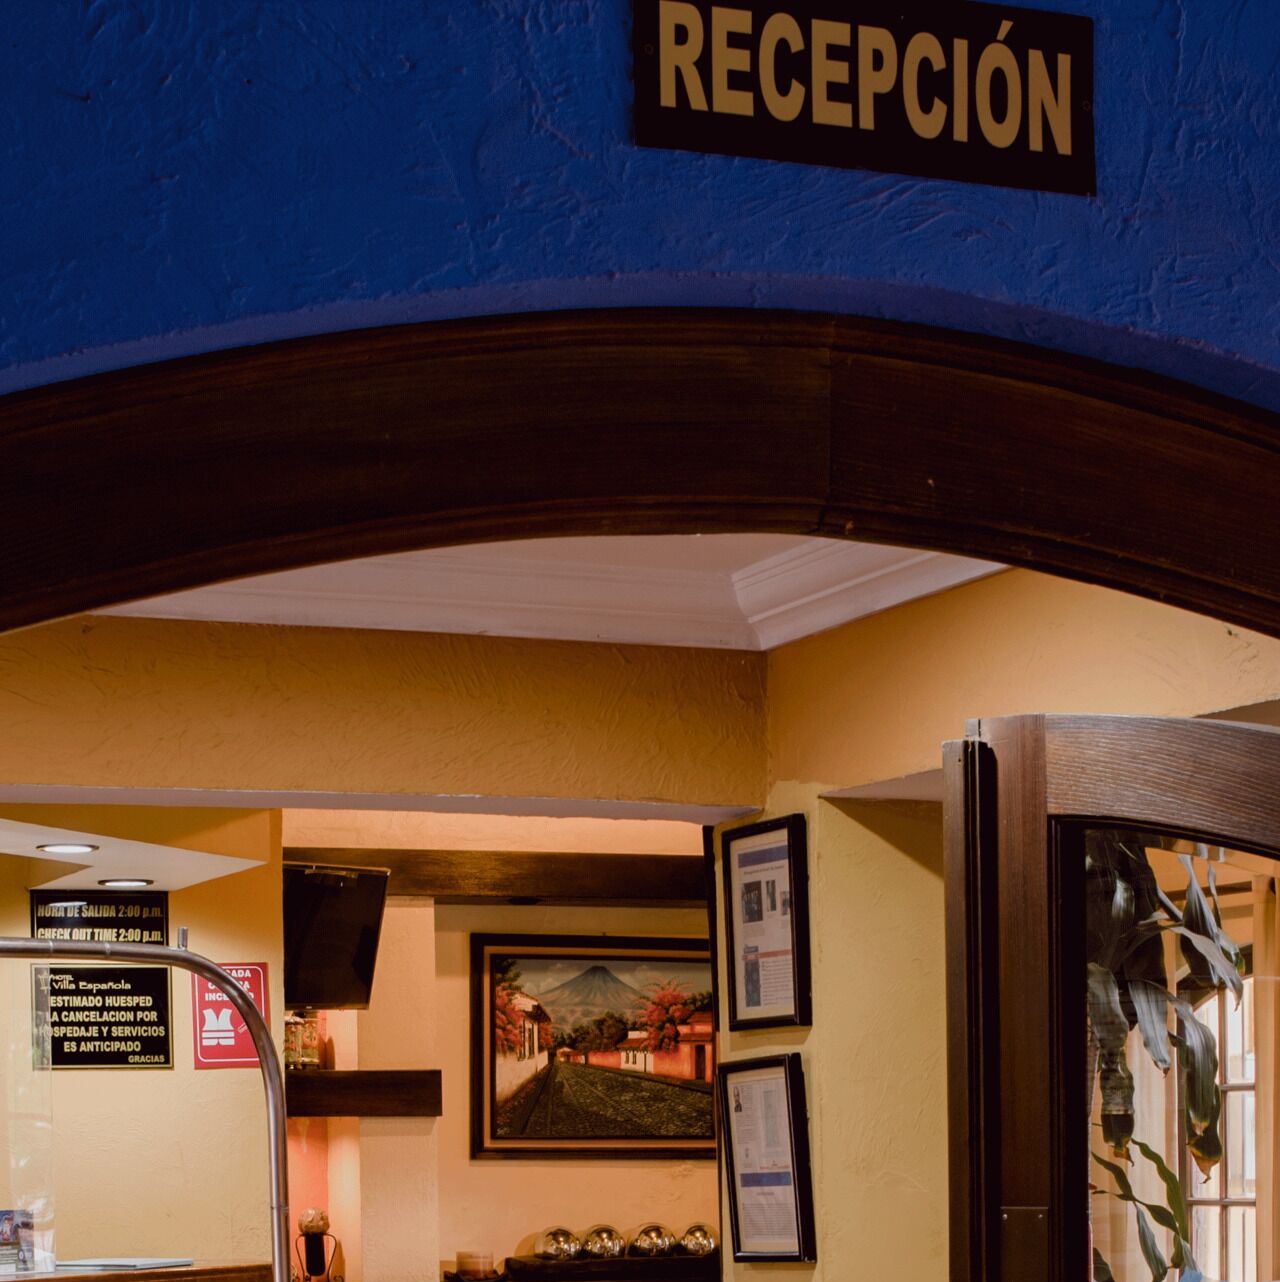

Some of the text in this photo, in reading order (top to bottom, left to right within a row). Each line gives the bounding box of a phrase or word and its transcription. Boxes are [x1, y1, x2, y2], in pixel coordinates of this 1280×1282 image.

[659, 2, 1072, 156] RECEPCIÓN
[37, 905, 163, 919] HORA DE SALIDA 2:00 p.m.
[37, 928, 163, 943] CHECK OUT TIME 2:00 p.m.
[52, 979, 132, 993] Villa Española
[50, 995, 153, 1007] ESTIMADO HUESPED
[46, 1010, 158, 1022] LA CANCELACION POR
[40, 1025, 166, 1037] HOSPEDAJE Y SERVICIOS
[63, 1041, 142, 1052] ES ANTICIPADO
[127, 1055, 166, 1063] GRACIAS
